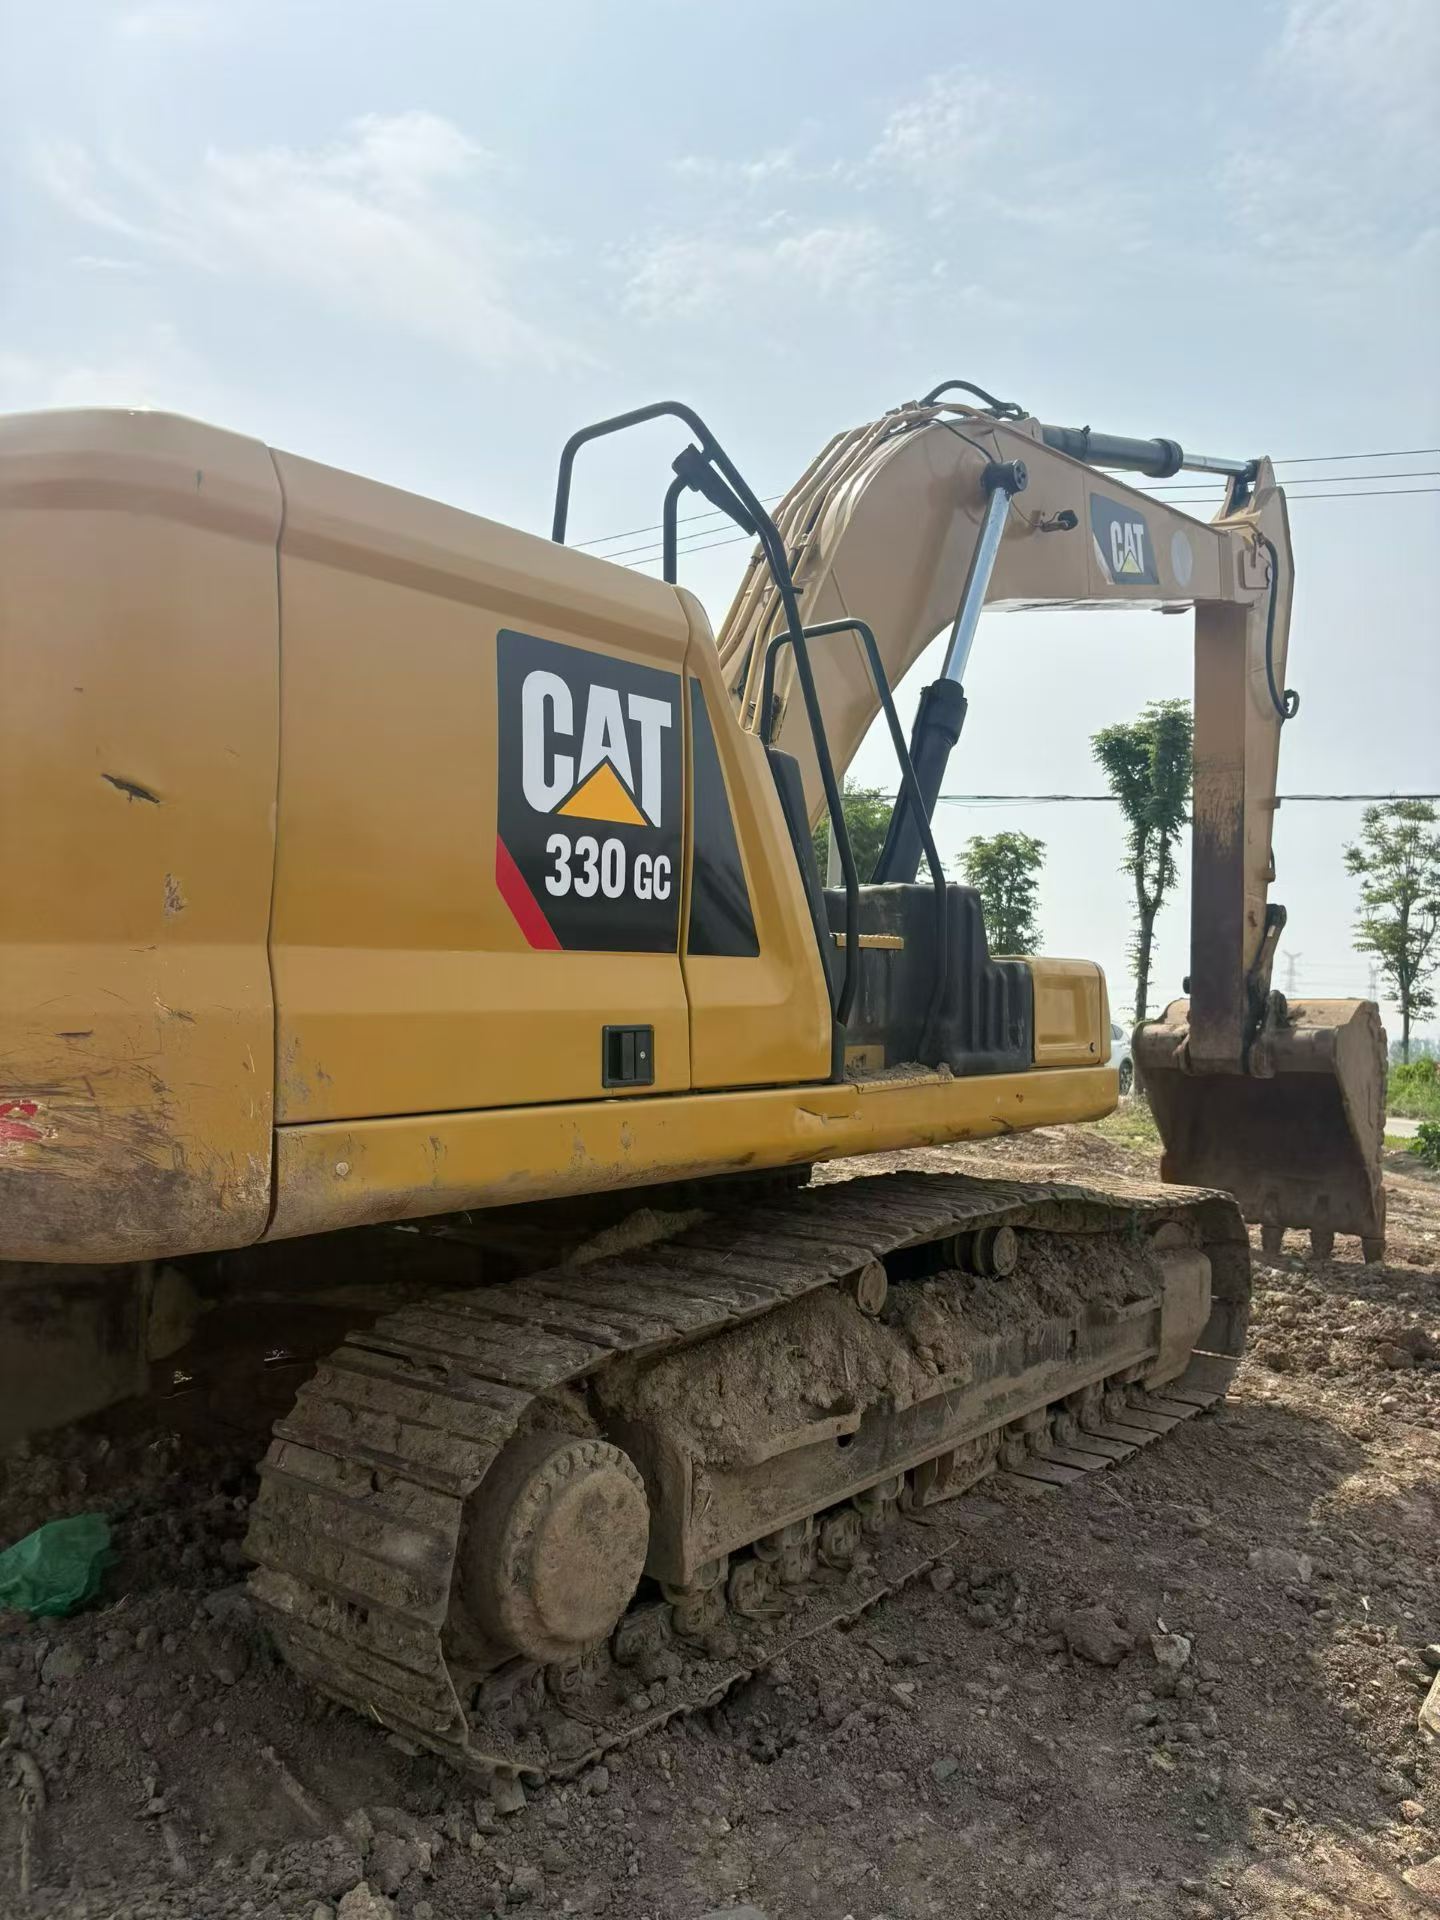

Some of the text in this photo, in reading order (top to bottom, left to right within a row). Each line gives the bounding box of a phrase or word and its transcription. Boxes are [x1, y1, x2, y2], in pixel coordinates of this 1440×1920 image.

[1110, 520, 1144, 573] CAT
[522, 670, 672, 828] CAT
[545, 833, 671, 900] 330 GC
